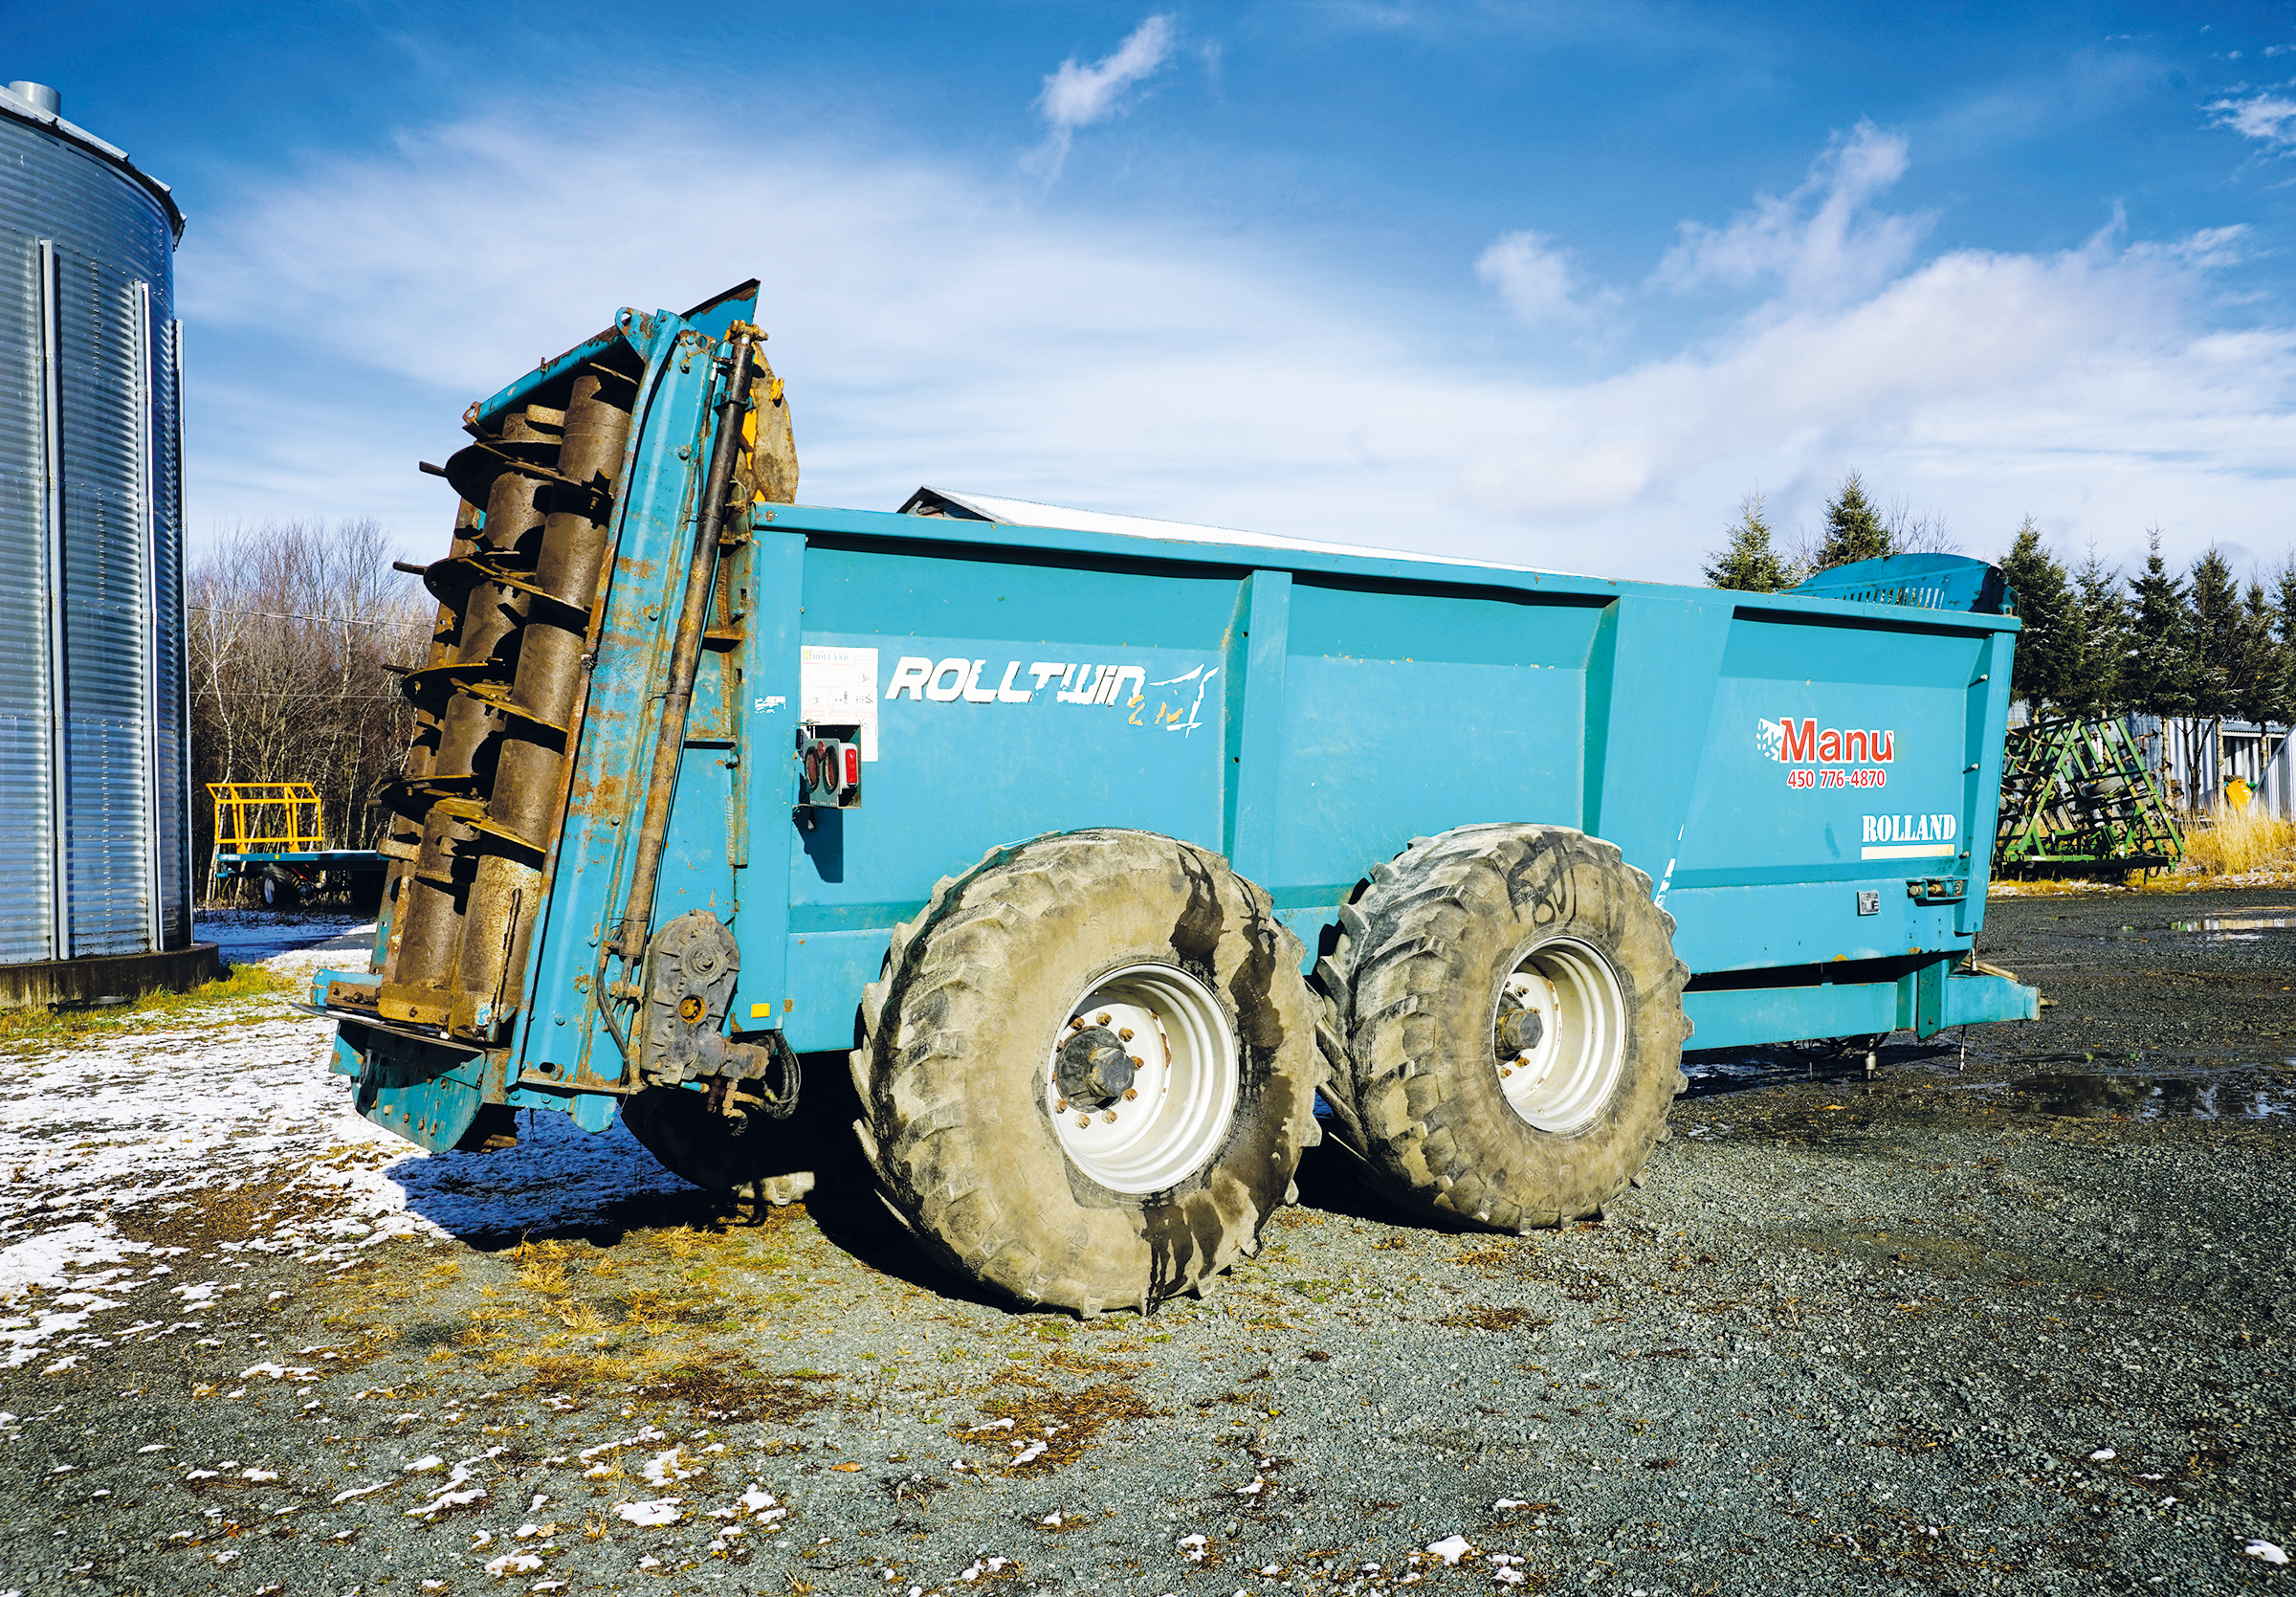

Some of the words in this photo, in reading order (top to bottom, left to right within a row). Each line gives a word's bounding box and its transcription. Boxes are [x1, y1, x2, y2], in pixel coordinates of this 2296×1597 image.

[1779, 718, 1894, 764] Manu
[1787, 769, 1816, 788] 450
[1820, 768, 1887, 788] 776-4870
[1862, 814, 1956, 842] ROLLAND
